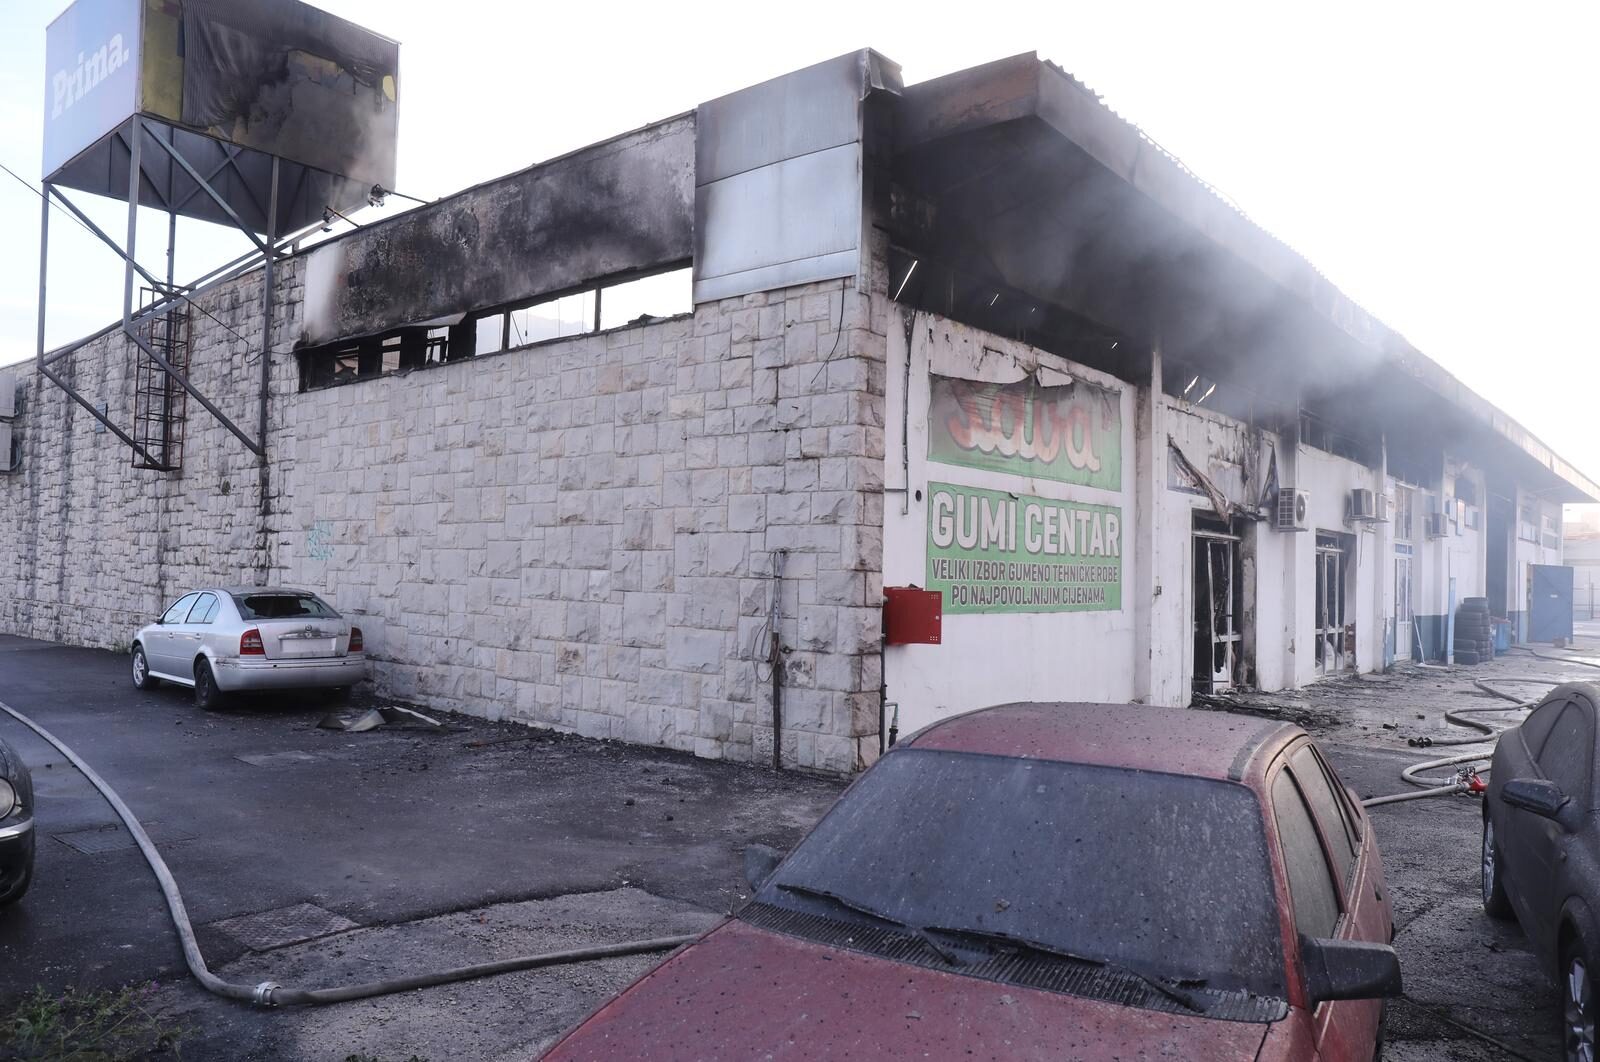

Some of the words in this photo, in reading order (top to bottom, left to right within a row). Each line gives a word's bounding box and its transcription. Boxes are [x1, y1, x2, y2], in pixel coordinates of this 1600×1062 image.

[931, 491, 1017, 551] GUMI
[1024, 503, 1120, 557] CENTAR
[932, 559, 970, 580] VELIKI
[973, 561, 1005, 581] IZBOR
[1008, 562, 1050, 582] GUMENO
[1097, 566, 1117, 583] ROBE
[952, 585, 968, 606] PO
[971, 585, 1060, 605] NAJPOVOLJNIJIM
[1062, 587, 1105, 604] CIJENAMA
